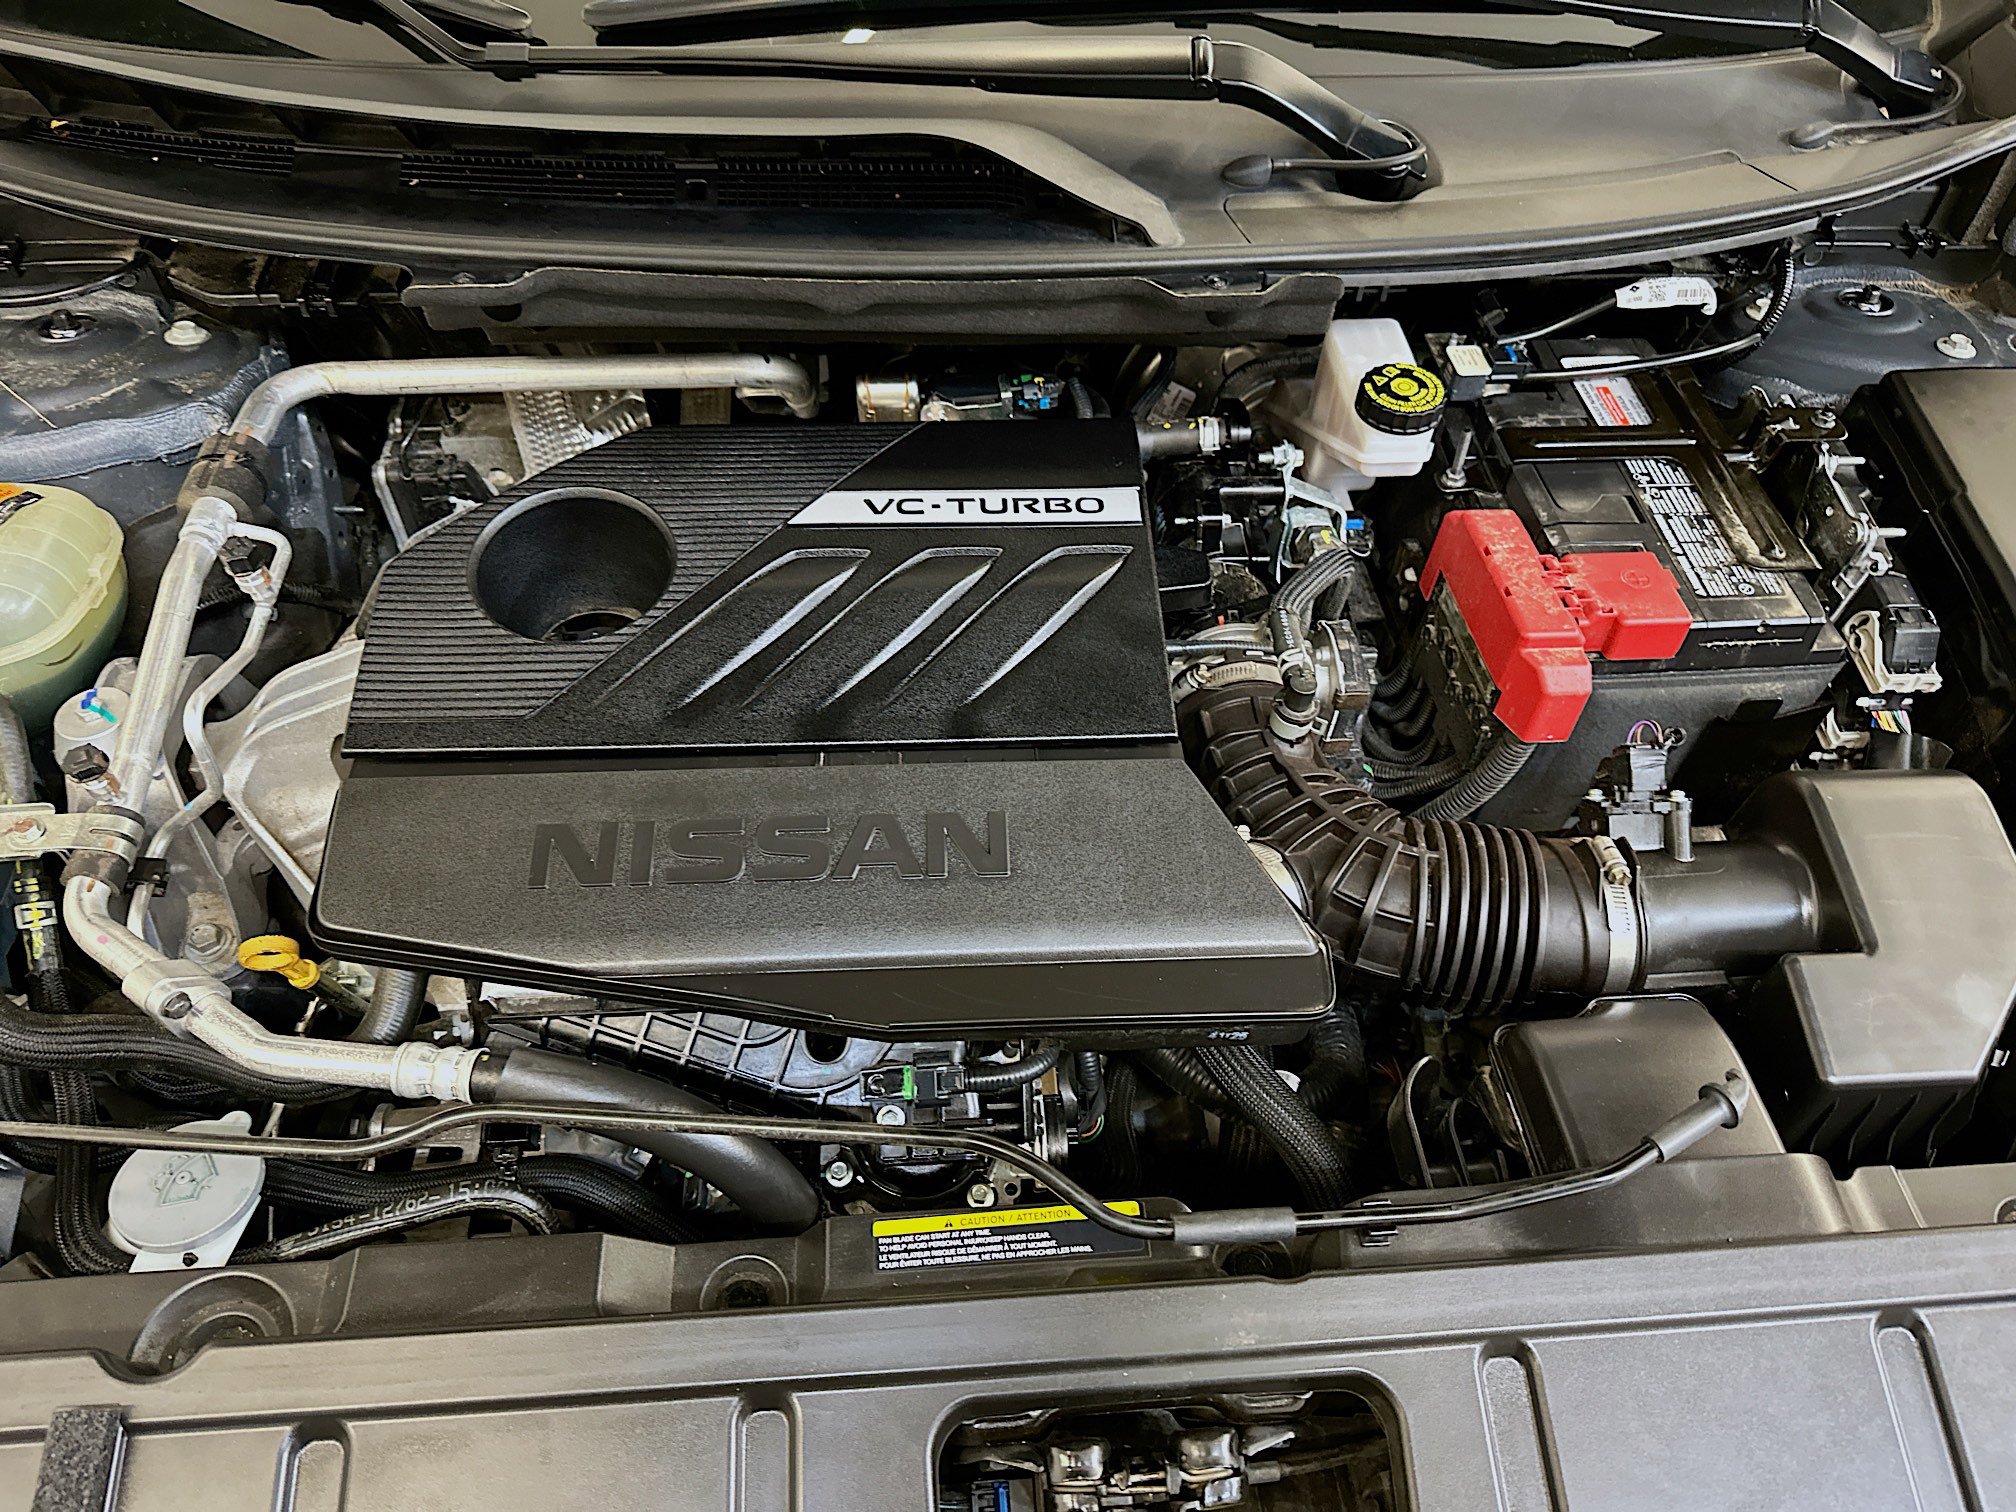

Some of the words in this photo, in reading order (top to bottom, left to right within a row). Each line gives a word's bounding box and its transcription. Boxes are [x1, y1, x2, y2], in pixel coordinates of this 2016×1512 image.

[863, 496, 1105, 515] VC-TURBO
[527, 810, 1012, 890] NISSAN
[960, 1214, 1004, 1226] CAUTION
[1016, 1209, 1070, 1221] ATTENTION
[893, 1235, 914, 1243] BLADE
[930, 1232, 950, 1240] START
[907, 1242, 927, 1250] AVOID
[928, 1239, 963, 1248] PERSONAL
[888, 1251, 930, 1260] VENTILATEUR
[967, 1243, 1003, 1253] DÉMARRER
[1004, 1242, 1009, 1250] À
[1027, 1240, 1057, 1248] MOMENT.
[899, 1258, 922, 1267] ÉVITER
[1016, 1248, 1056, 1257] APPROCHER
[1070, 1245, 1093, 1253] MAINS.
